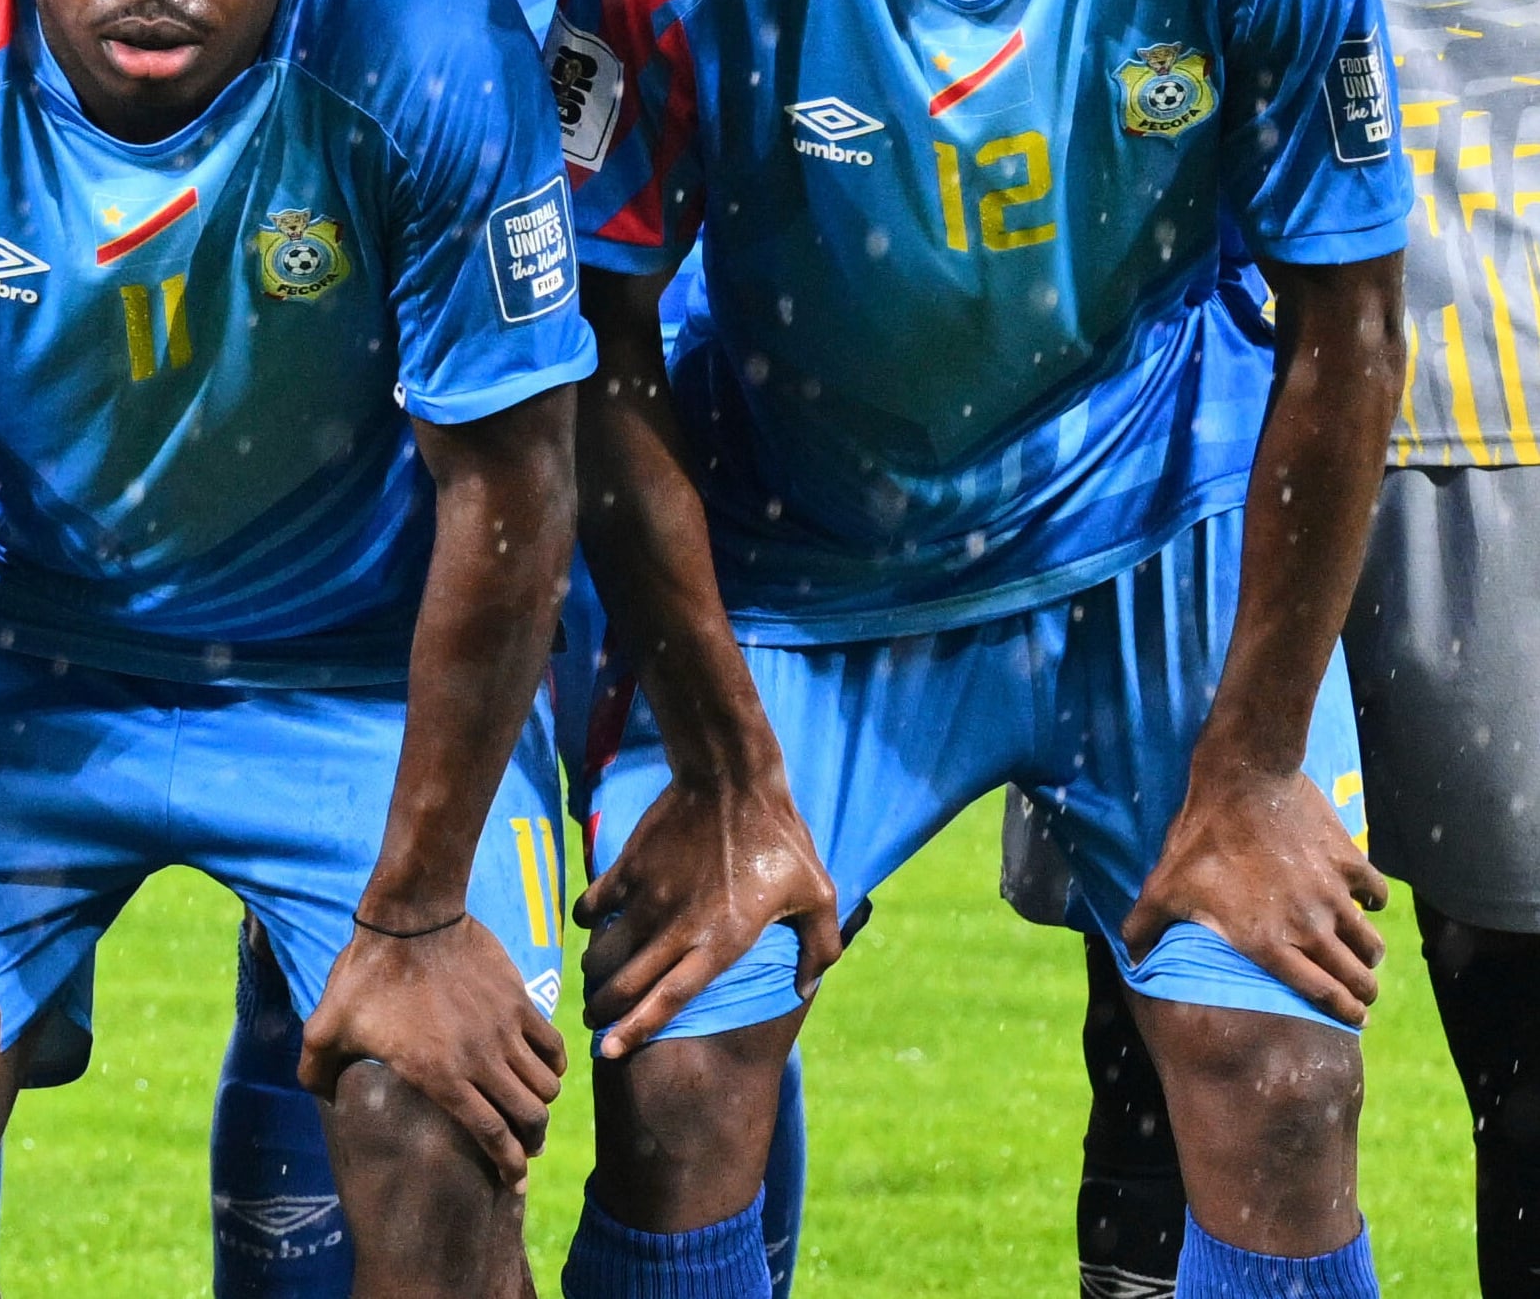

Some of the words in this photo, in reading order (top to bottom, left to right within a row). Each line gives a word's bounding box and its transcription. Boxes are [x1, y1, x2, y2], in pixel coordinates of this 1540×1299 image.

[1139, 109, 1201, 130] FECOFA
[1343, 101, 1369, 121] the
[793, 137, 873, 165] umbro
[931, 128, 1057, 254] 12
[505, 199, 558, 234] FOOTBALL
[508, 217, 563, 258] UNITES
[509, 259, 536, 280] the
[537, 237, 567, 272] World
[277, 273, 339, 295] FECOFA
[538, 275, 559, 291] FIFA
[120, 273, 191, 383] 11
[509, 816, 563, 948] 11
